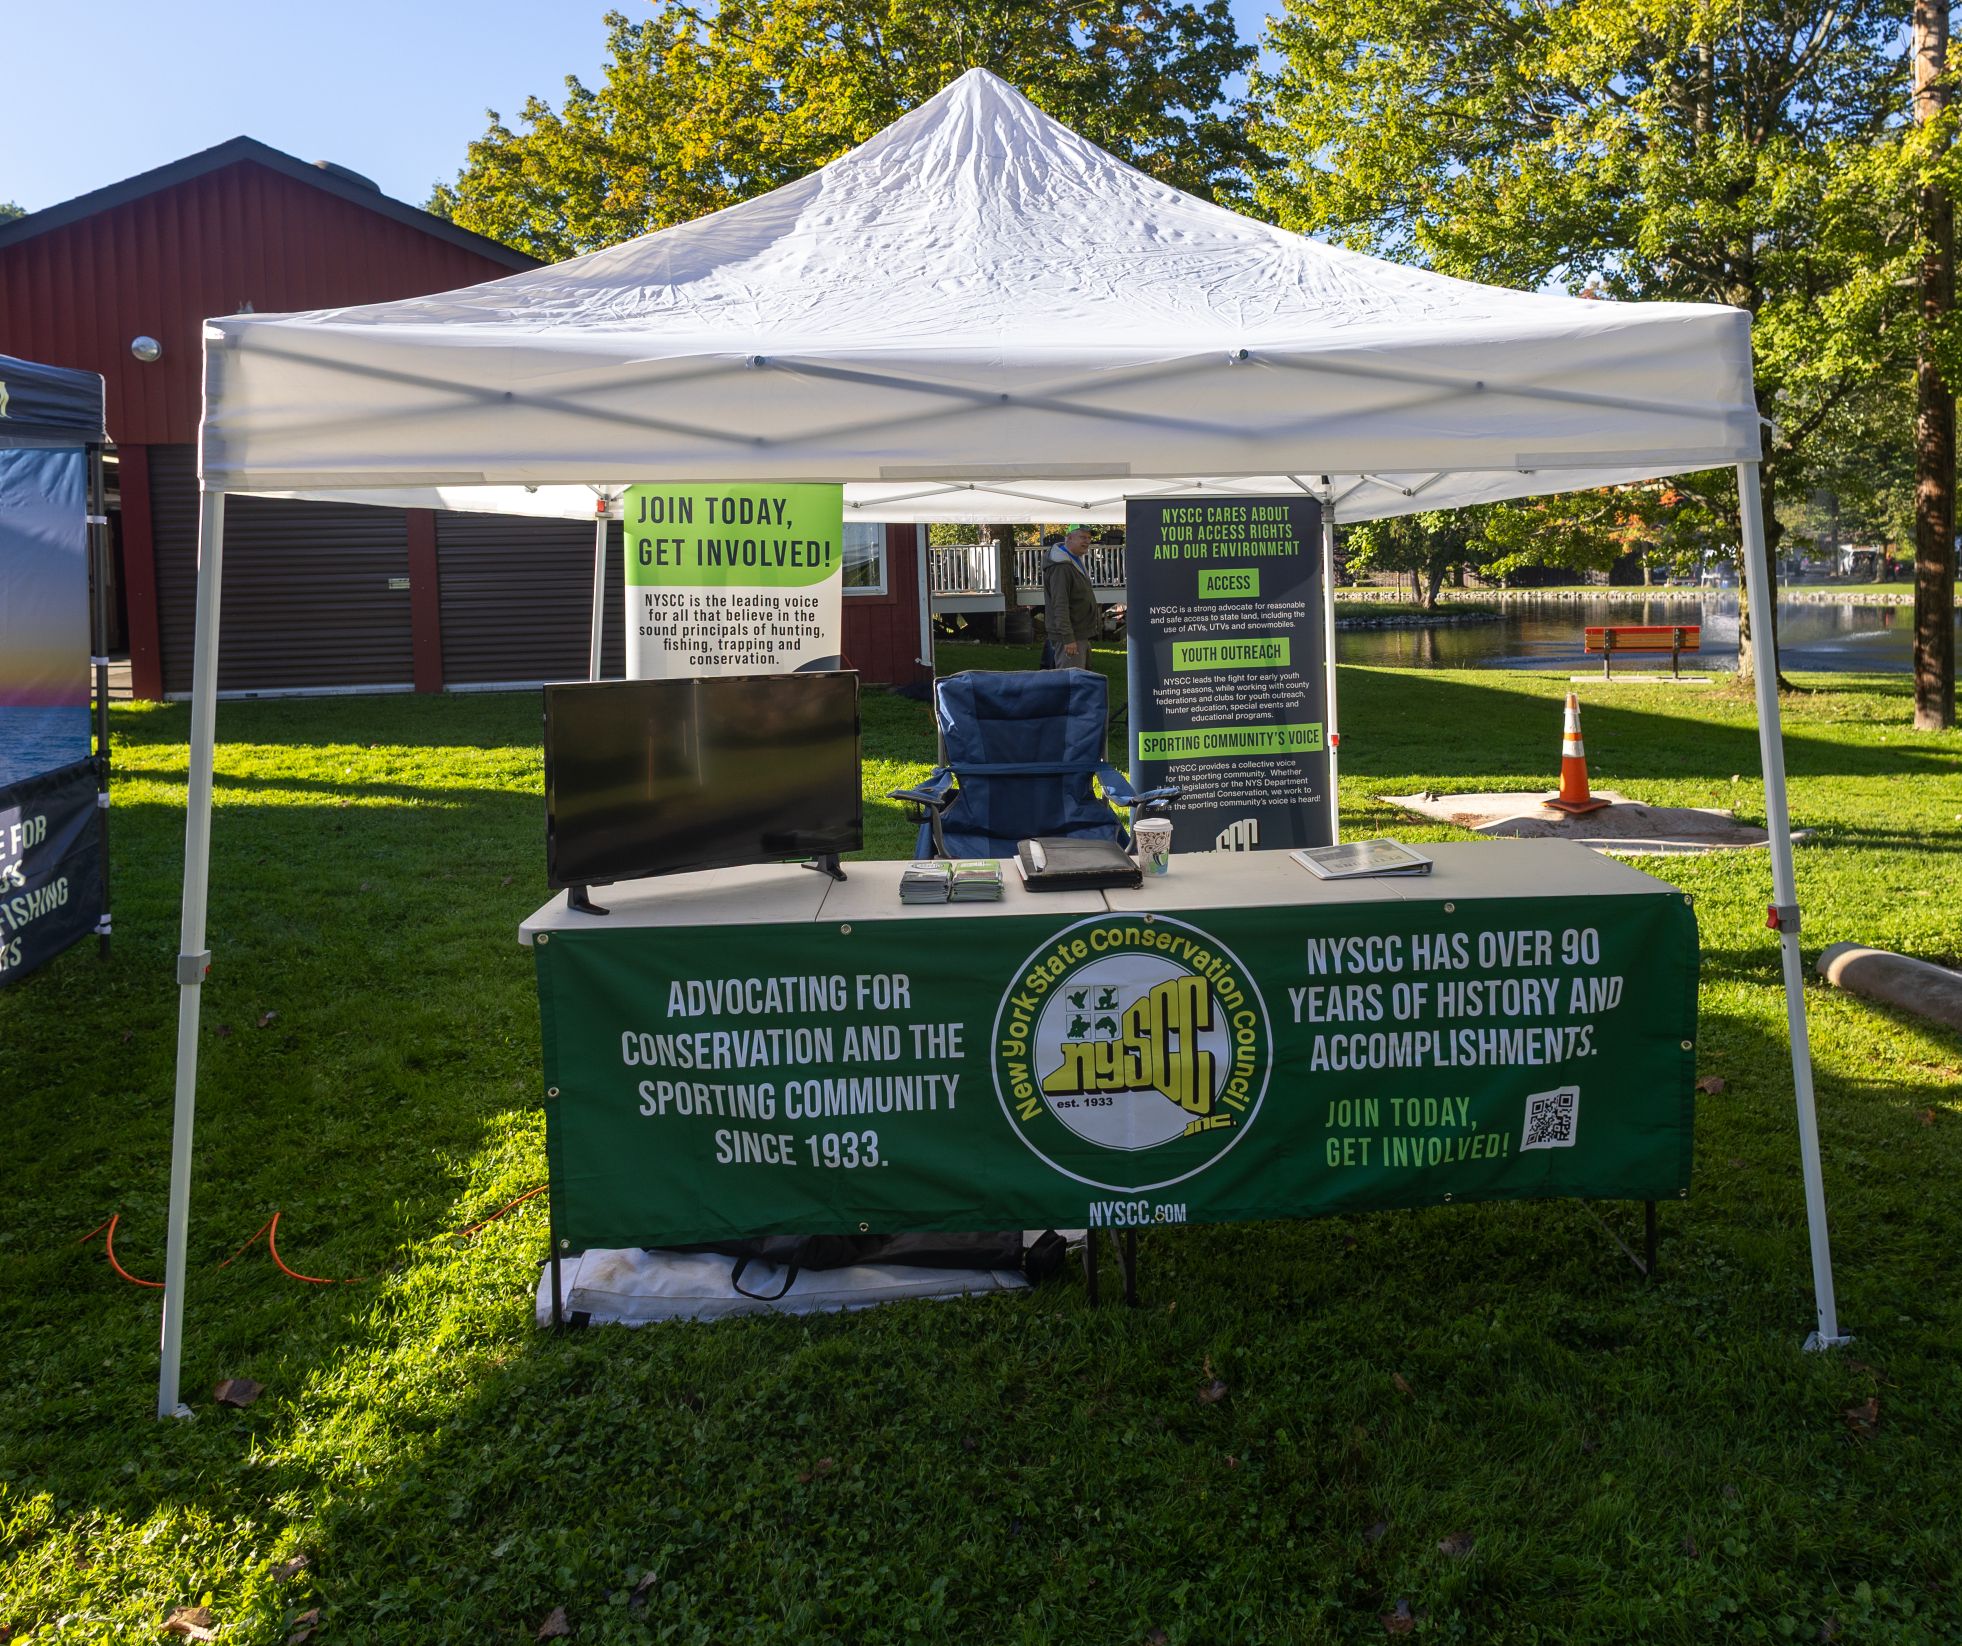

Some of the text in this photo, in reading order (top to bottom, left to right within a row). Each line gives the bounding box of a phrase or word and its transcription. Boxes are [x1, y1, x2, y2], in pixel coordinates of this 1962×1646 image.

[638, 496, 793, 529] JOIN TODAY,
[1163, 507, 1289, 523] NYSCC CARES ABOUT
[1161, 524, 1292, 541] YOUR ACCESS RIGHTS
[639, 539, 830, 567] GET INVOLVED!
[1154, 541, 1299, 559] AND OUR ENVIRONMENT
[1207, 576, 1250, 591] ACCESS
[645, 594, 818, 609] NYSCC is the leading voice
[1267, 601, 1305, 609] reasonable
[649, 609, 815, 622] for all that believe in the
[1151, 616, 1164, 624] and
[1241, 612, 1259, 620] land,
[1261, 612, 1291, 620] including
[639, 624, 825, 639] sound principals of hunting,
[1188, 624, 1207, 632] ATVs,
[1210, 623, 1229, 631] UTVs
[1248, 621, 1295, 629] snowmobiles.
[663, 638, 800, 653] fishing, trapping and
[1182, 644, 1281, 662] YOUTH OUTREACH
[690, 653, 779, 665] conservation.
[1164, 677, 1191, 685] NYSCC
[1193, 676, 1212, 684] leads
[1228, 675, 1244, 683] fight
[1260, 673, 1278, 682] early
[1280, 672, 1299, 681] youth
[1153, 688, 1180, 697] hunting
[1237, 683, 1266, 692] working
[1286, 682, 1309, 690] county
[1156, 696, 1197, 705] federations
[1249, 692, 1270, 700] youth
[1272, 691, 1305, 699] outreach,
[1166, 706, 1189, 714] hunter
[1191, 704, 1228, 712] education,
[1231, 702, 1257, 711] special
[1192, 712, 1273, 722] educational programs.
[1144, 729, 1319, 752] SPORTING COMMUNITY'S VOICE
[1169, 764, 1196, 772] NYSCC
[1199, 763, 1229, 771] provides
[1239, 760, 1274, 768] collective
[1192, 772, 1221, 781] sporting
[1224, 770, 1266, 779] community.
[1182, 782, 1218, 791] legislators
[1246, 779, 1262, 787] NYS
[1265, 777, 1308, 786] Department
[1218, 789, 1268, 797] Conservation,
[1188, 801, 1218, 810] sporting
[1220, 798, 1266, 807] community's
[1299, 795, 1320, 803] heard!
[10, 815, 47, 855] FOR
[1307, 928, 1600, 975] NYSCC HAS OVER 90
[667, 973, 910, 1017] ADVOCATING FOR
[1288, 976, 1623, 1023] YEARS OF HISTORY AND
[1009, 1062, 1043, 1121] New
[1026, 939, 1088, 993] State
[1090, 927, 1244, 1010] Conservation
[1222, 1009, 1256, 1112] Council
[621, 1022, 965, 1070] CONSERVATION AND THE
[1310, 1024, 1597, 1072] ACCOMPLISHMENTS.
[638, 1074, 960, 1120] SPORTING COMMUNITY
[1057, 1097, 1113, 1108] est. 1933
[1326, 1097, 1477, 1130] JOIN TODAY,
[715, 1129, 888, 1169] SINCE 1933.
[1326, 1133, 1510, 1168] GET INVOLVED!
[1090, 1201, 1186, 1227] NYSCC.COM
